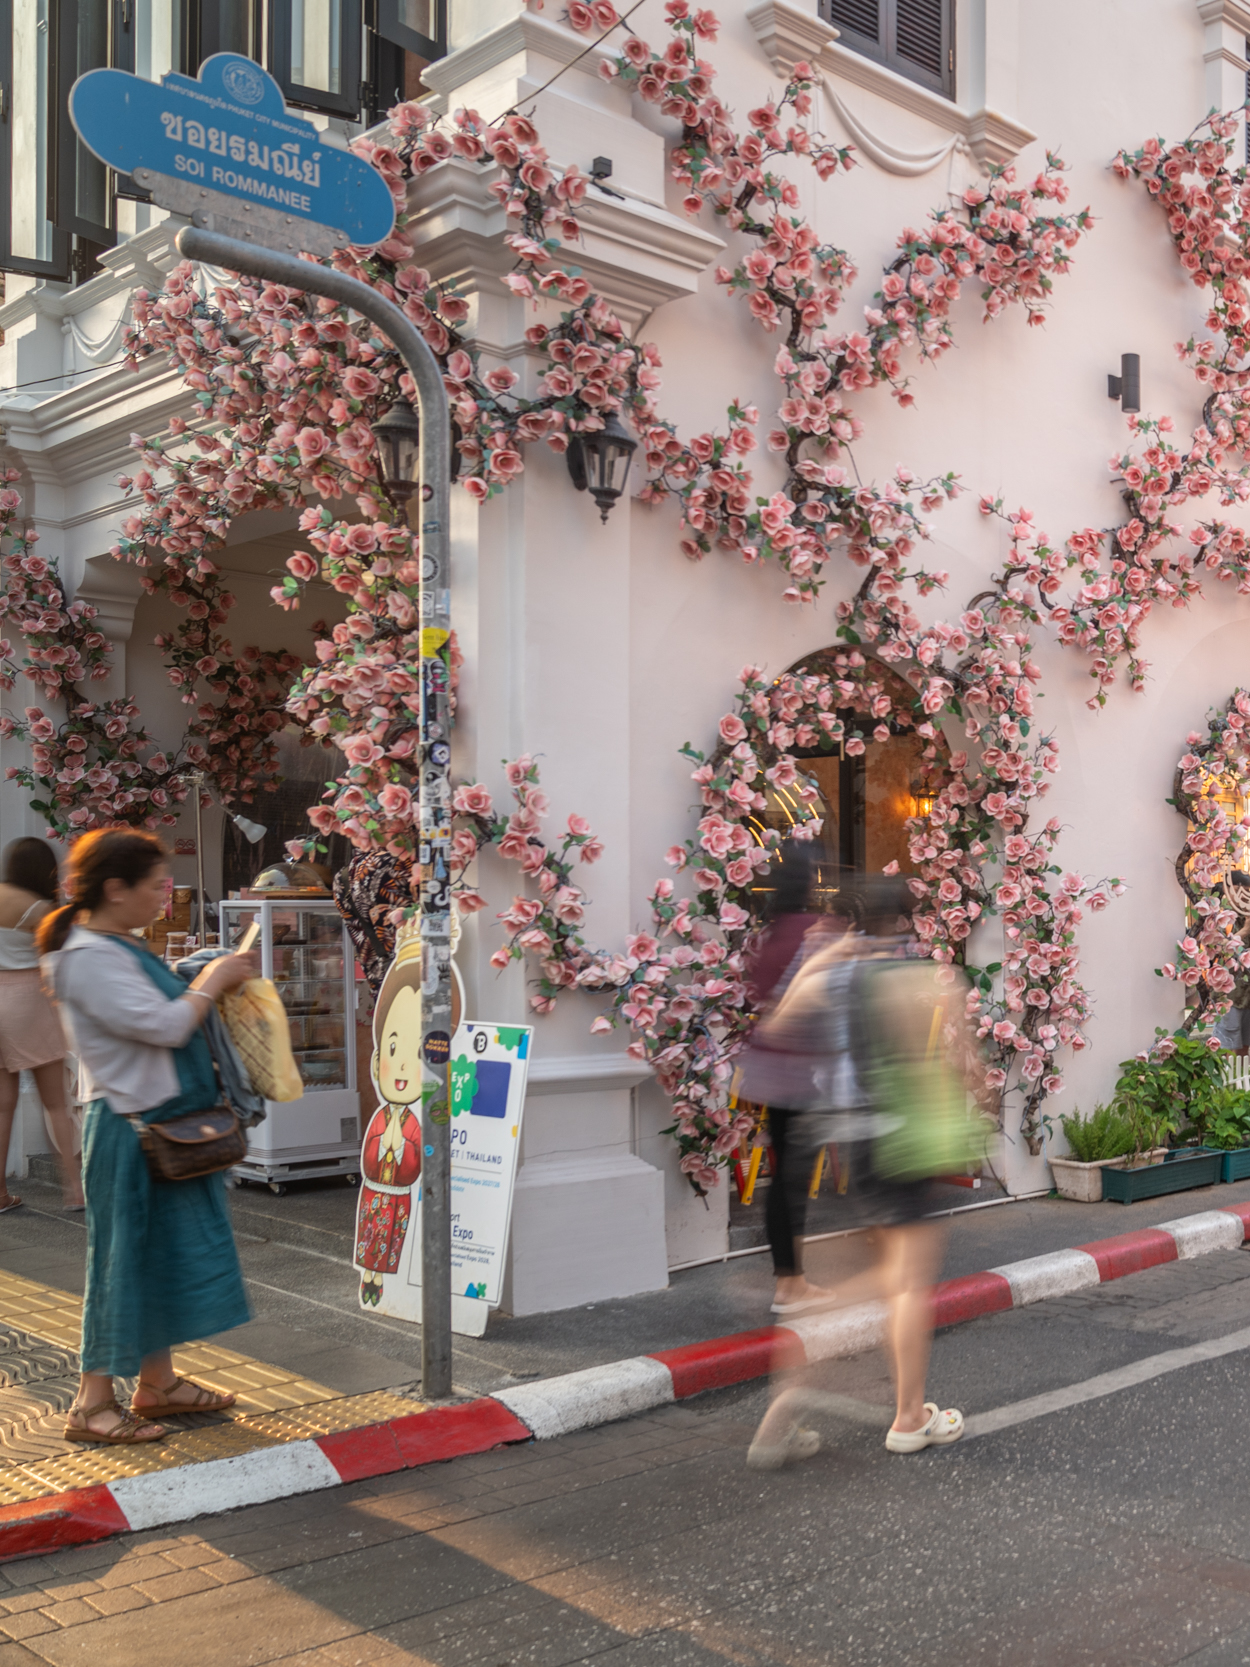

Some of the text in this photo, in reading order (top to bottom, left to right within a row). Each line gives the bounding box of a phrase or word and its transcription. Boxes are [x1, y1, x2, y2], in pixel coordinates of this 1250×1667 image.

[227, 103, 254, 119] PHUKET
[255, 113, 271, 125] CITY
[271, 120, 316, 141] MUNICIPALITY
[174, 154, 312, 213] SOI ROMMANEE
[450, 1129, 467, 1145] PO
[466, 1151, 503, 1165] THAILAND
[452, 1225, 474, 1241] Expo
